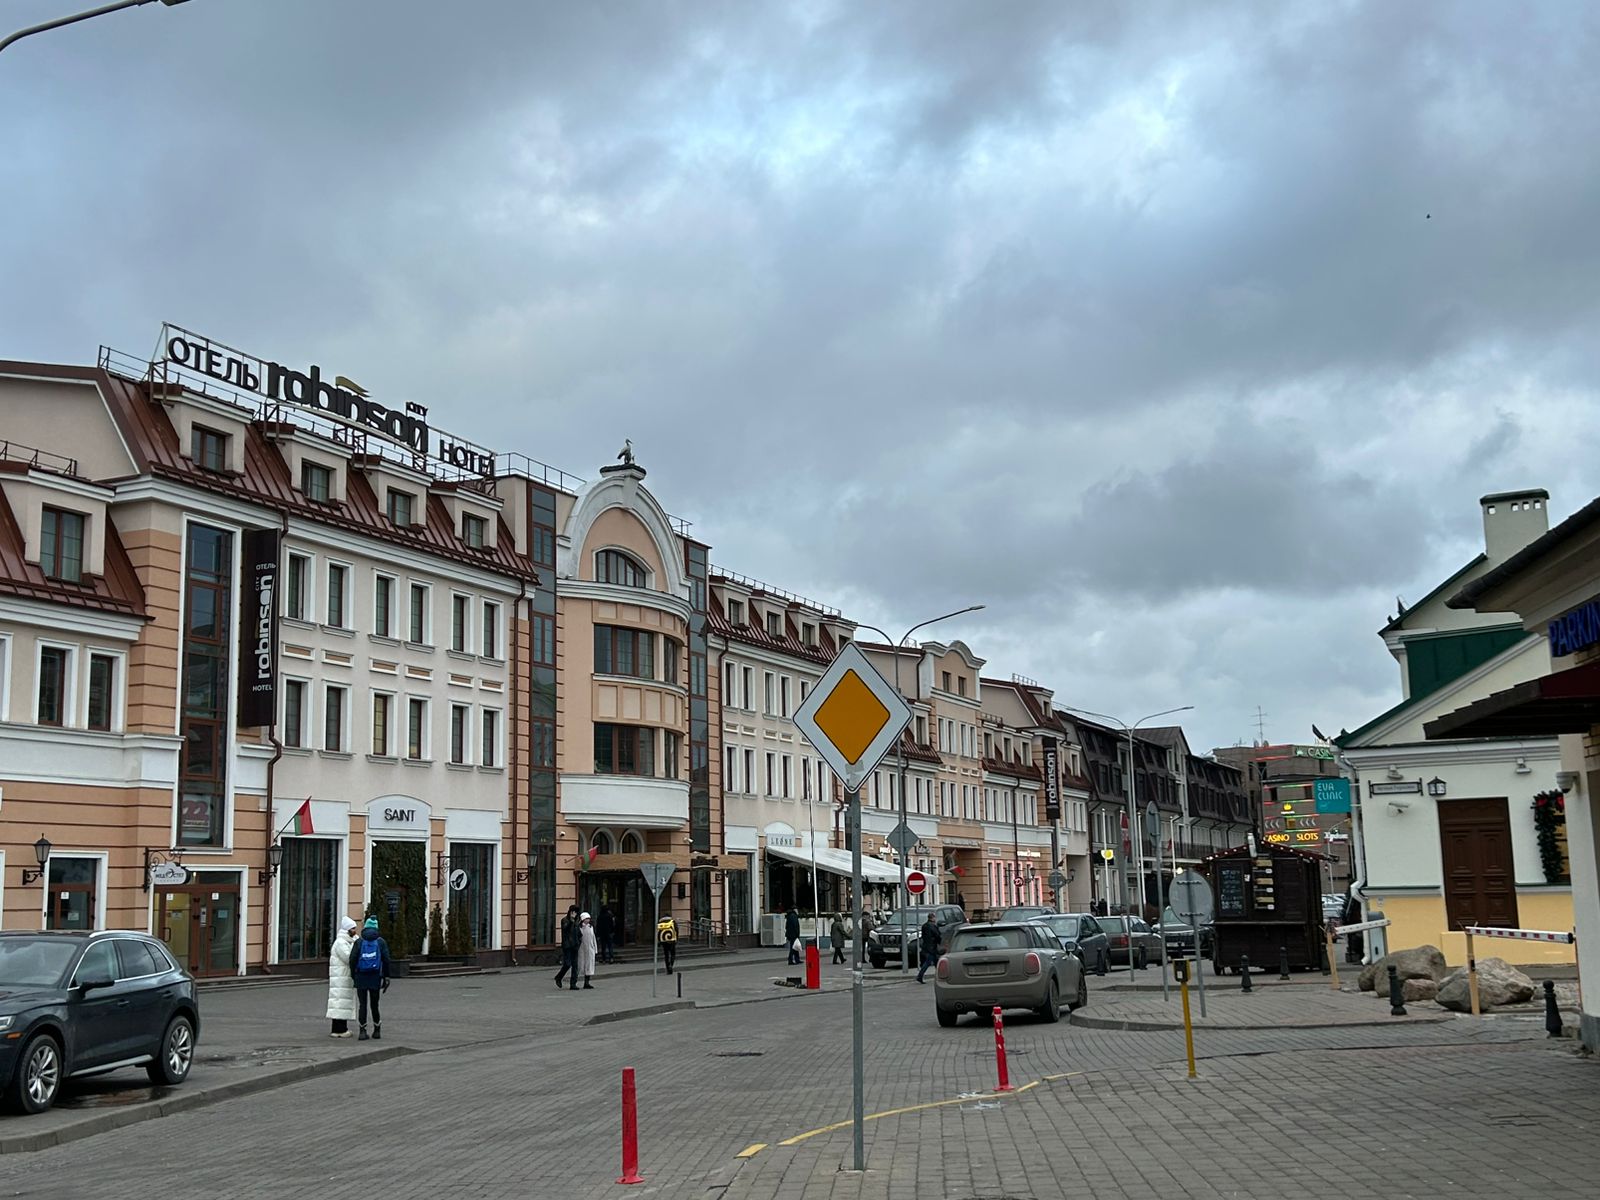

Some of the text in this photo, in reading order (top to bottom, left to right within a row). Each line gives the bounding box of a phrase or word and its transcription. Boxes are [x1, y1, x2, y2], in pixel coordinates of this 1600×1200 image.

[168, 337, 259, 391] ОТЕЛЬ
[268, 362, 428, 453] robinson
[406, 401, 428, 416] CITY
[255, 562, 276, 571] ОТЕЛЬ
[255, 575, 272, 678] robinson
[252, 684, 273, 692] HOTEL
[1046, 752, 1057, 804] robinson
[1317, 783, 1335, 792] EVA
[1317, 791, 1343, 801] CLINIC
[384, 808, 416, 822] SAINT
[1296, 833, 1319, 841] SLOTS
